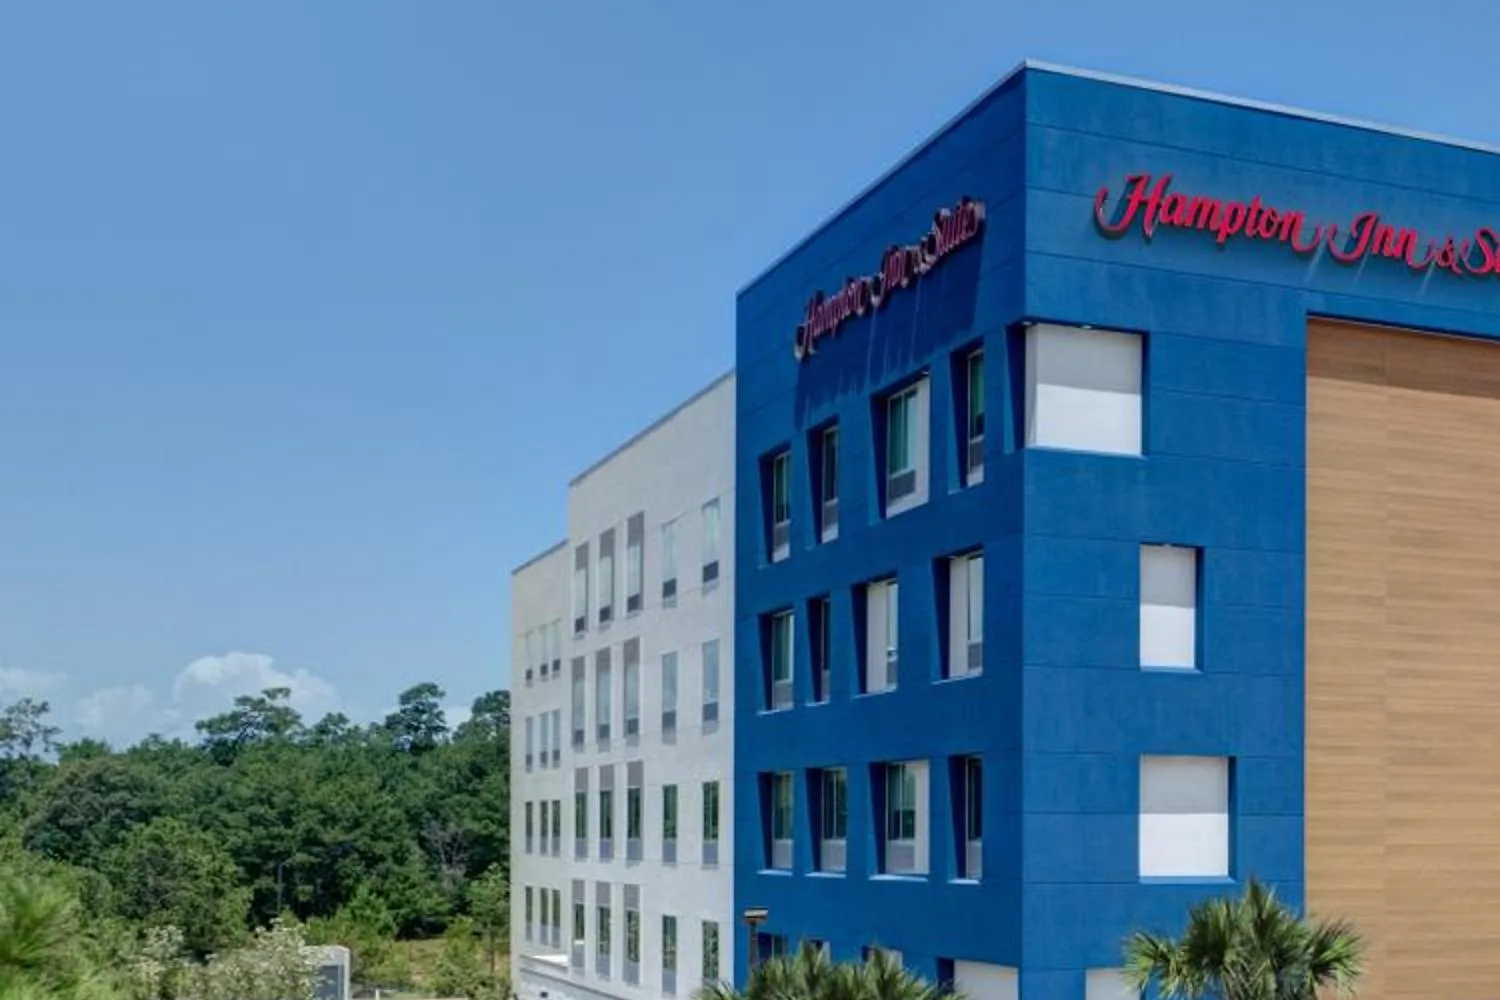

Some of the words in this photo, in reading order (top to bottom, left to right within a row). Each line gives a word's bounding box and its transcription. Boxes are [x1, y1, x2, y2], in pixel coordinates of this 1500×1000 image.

[1093, 173, 1323, 252] Hampton
[1328, 211, 1436, 268] Inn
[1436, 237, 1464, 274] &
[795, 276, 870, 362] Hampton
